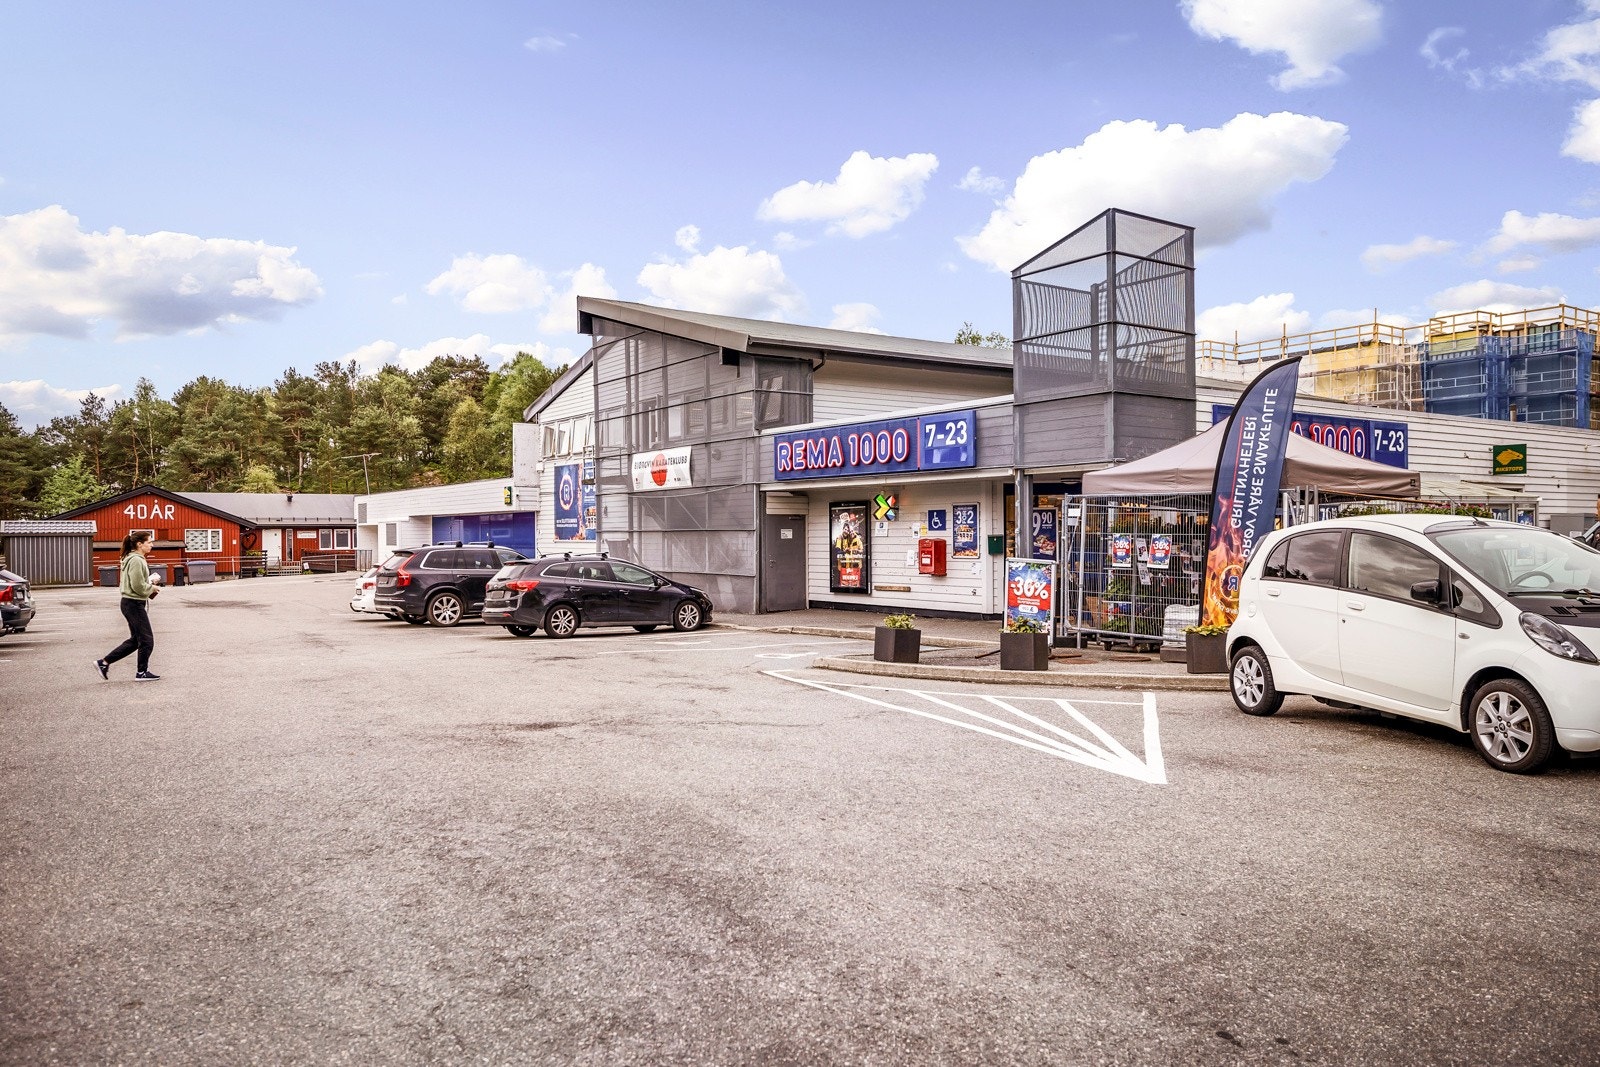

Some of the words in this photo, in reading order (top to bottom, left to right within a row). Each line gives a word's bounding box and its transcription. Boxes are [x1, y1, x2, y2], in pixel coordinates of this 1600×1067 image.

[925, 420, 968, 448] 7-23
[1374, 429, 1404, 452] 7-23
[777, 435, 844, 472] REMA
[848, 428, 910, 467] 1000
[123, 504, 147, 520] 40
[149, 499, 175, 520] ÅR
[956, 510, 962, 524] 3
[967, 510, 974, 524] 2
